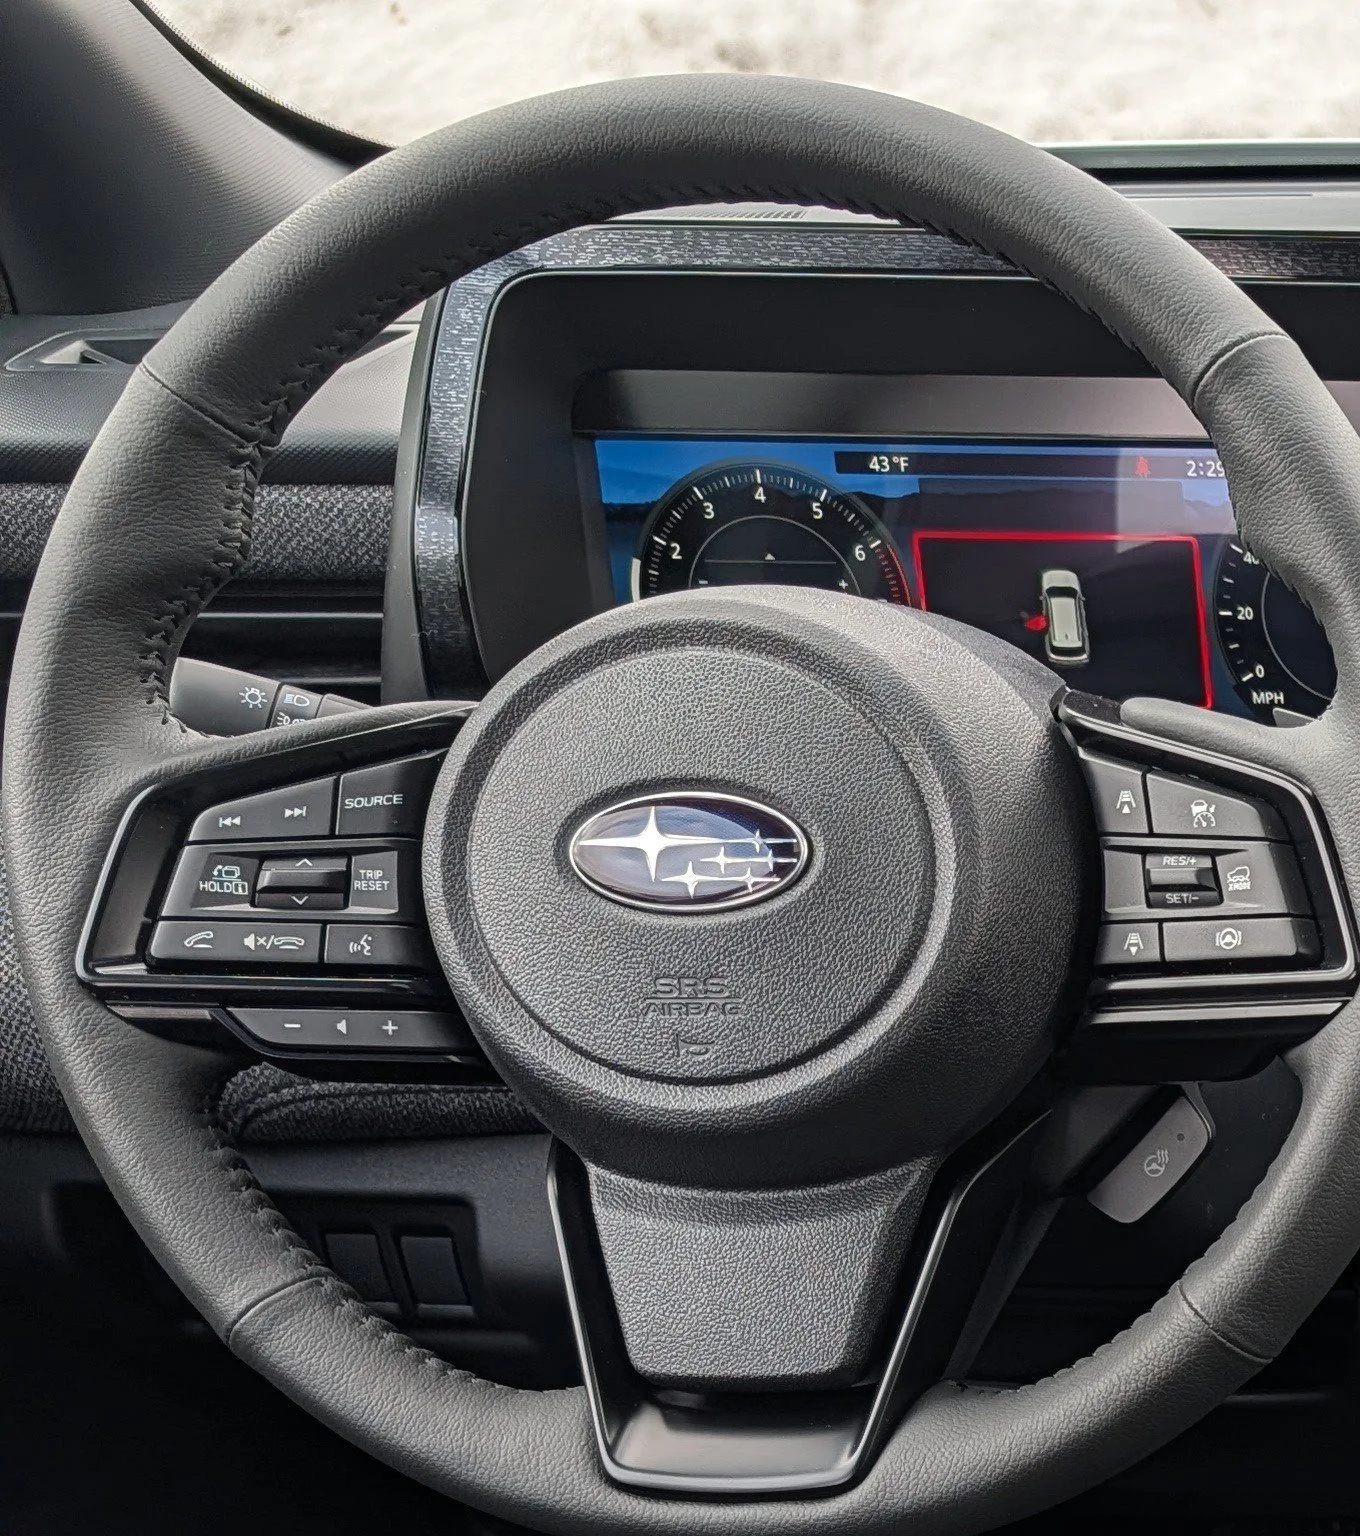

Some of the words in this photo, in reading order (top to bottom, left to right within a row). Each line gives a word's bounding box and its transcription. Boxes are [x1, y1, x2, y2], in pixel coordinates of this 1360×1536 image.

[754, 486, 766, 502] 4
[704, 502, 714, 520] 3
[812, 502, 823, 519] 5
[670, 543, 682, 560] 2
[854, 544, 866, 561] 6
[1237, 606, 1254, 620] 20
[1255, 665, 1265, 678] 0
[1252, 692, 1285, 705] MPH
[344, 794, 403, 809] SOURCE
[359, 870, 382, 880] TRIP
[199, 881, 234, 894] HOLD
[354, 879, 390, 891] RESET
[654, 976, 730, 997] SRS
